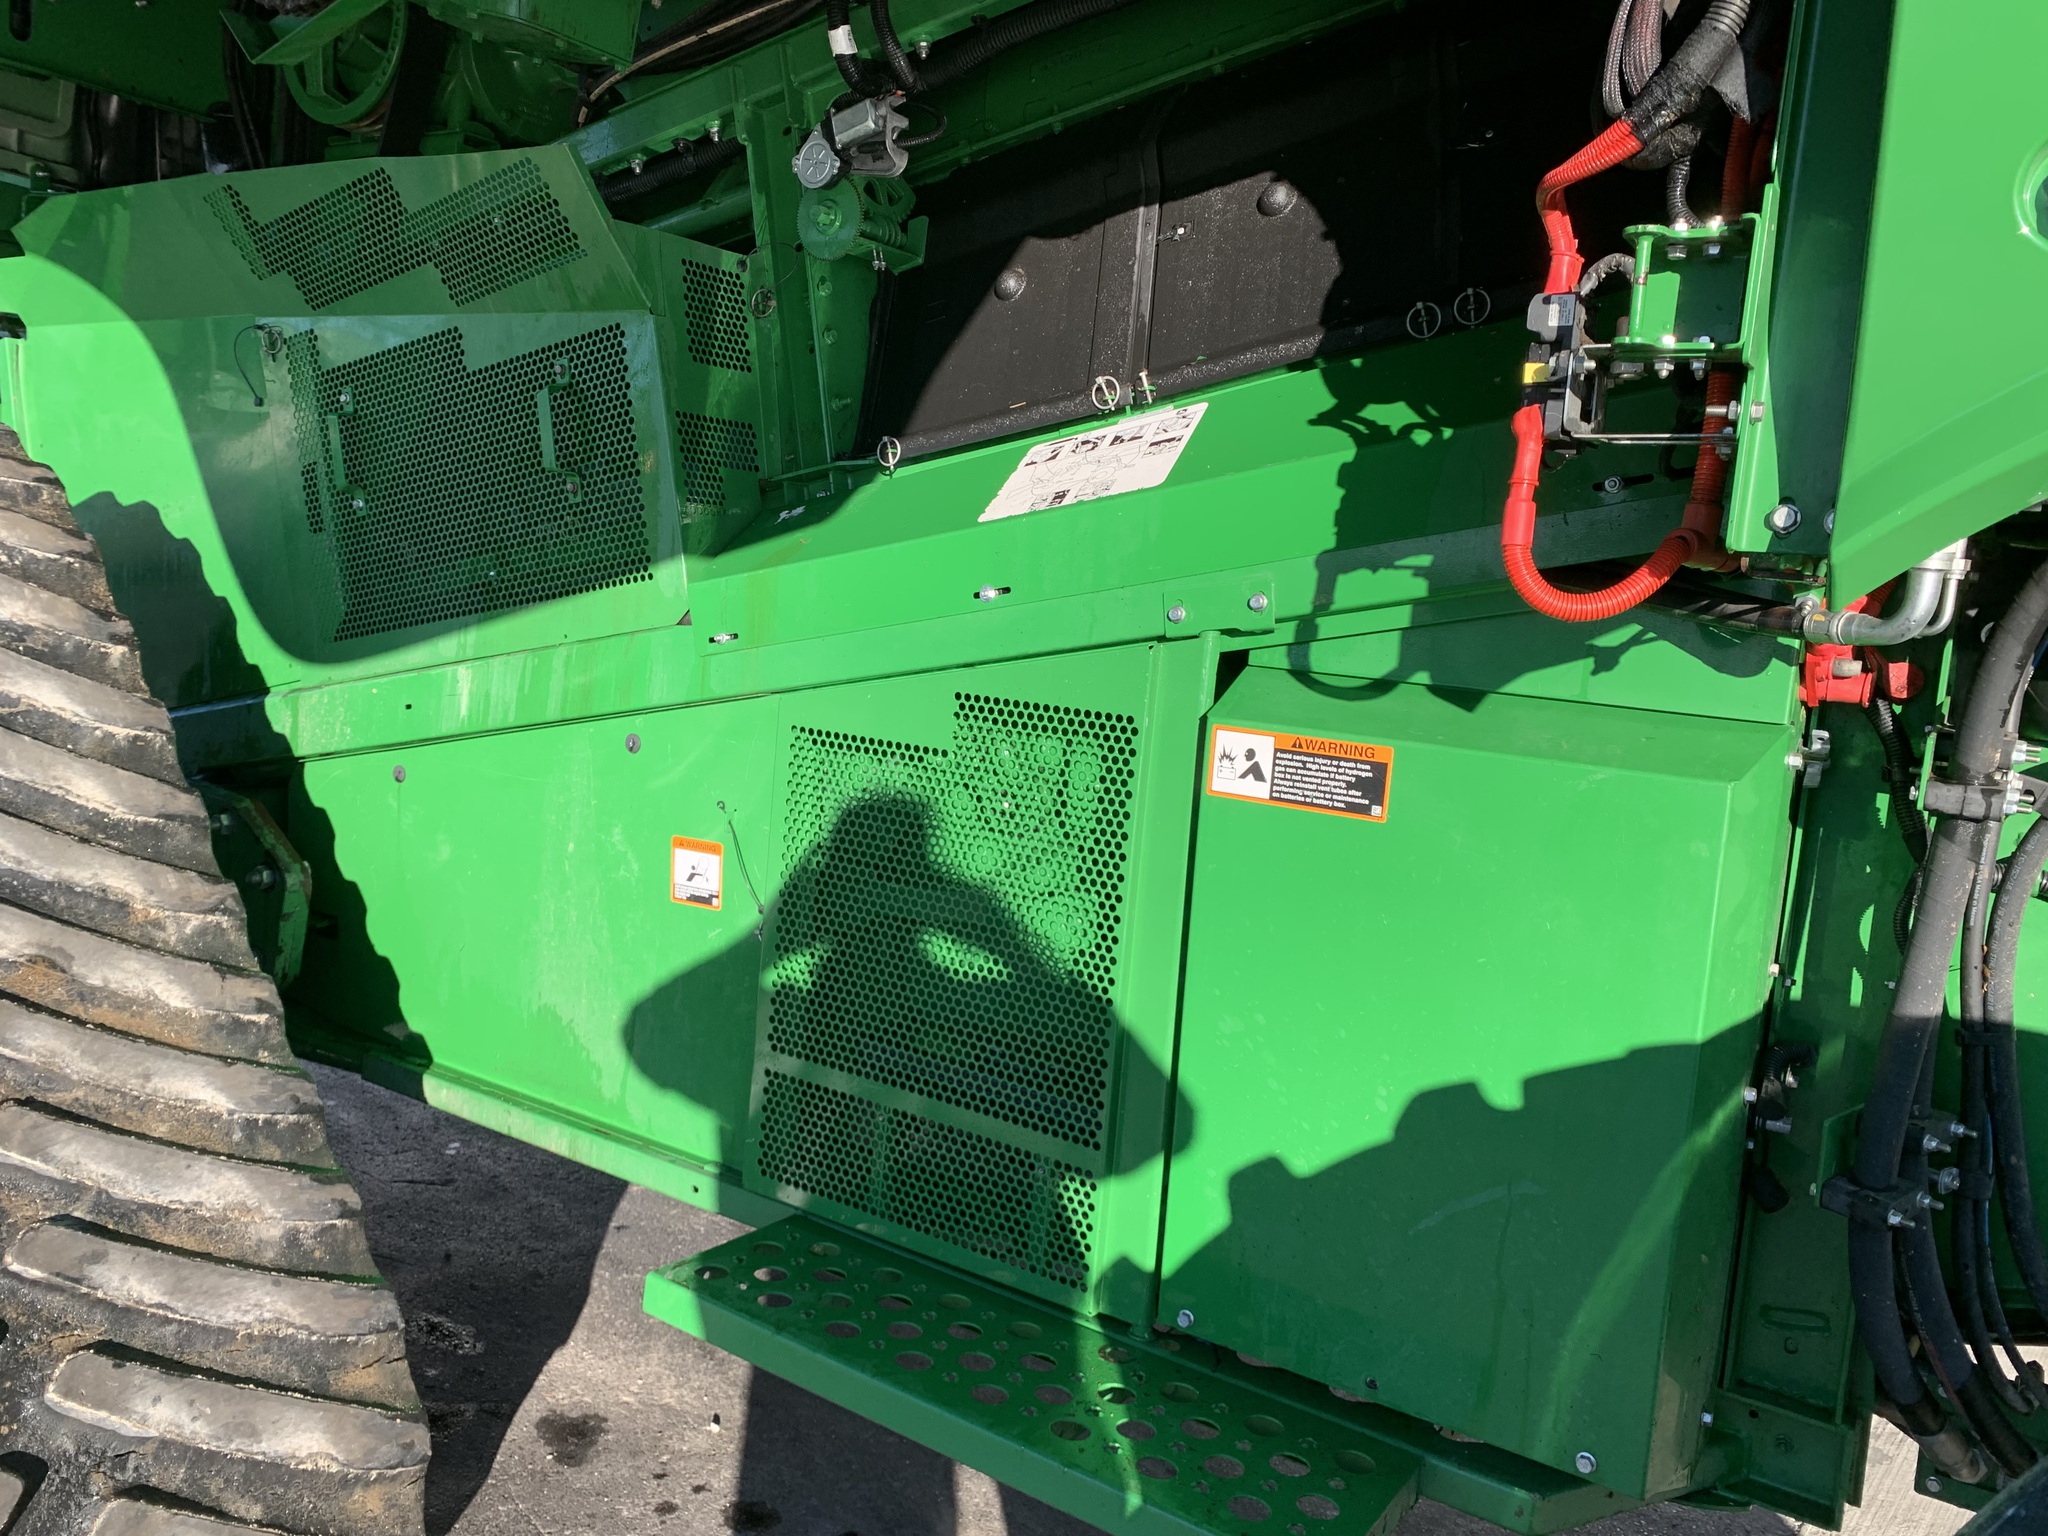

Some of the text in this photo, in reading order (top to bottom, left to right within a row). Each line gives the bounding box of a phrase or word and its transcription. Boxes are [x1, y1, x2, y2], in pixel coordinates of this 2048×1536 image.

[1304, 738, 1375, 759] WARNING
[1315, 757, 1331, 765] injury
[1275, 759, 1303, 767] explosion.
[1345, 768, 1373, 778] hydrogen
[1297, 769, 1329, 778] accumulate
[1335, 773, 1356, 783] battery
[1294, 782, 1317, 790] reinstall
[1322, 780, 1347, 788] properly.
[1272, 786, 1303, 795] performing
[1304, 790, 1324, 798] service
[1332, 794, 1369, 805] maintenance
[1280, 793, 1304, 801] batteries
[1313, 798, 1333, 807] battery
[686, 841, 716, 852] WARNING
[1973, 884, 1982, 900] Made
